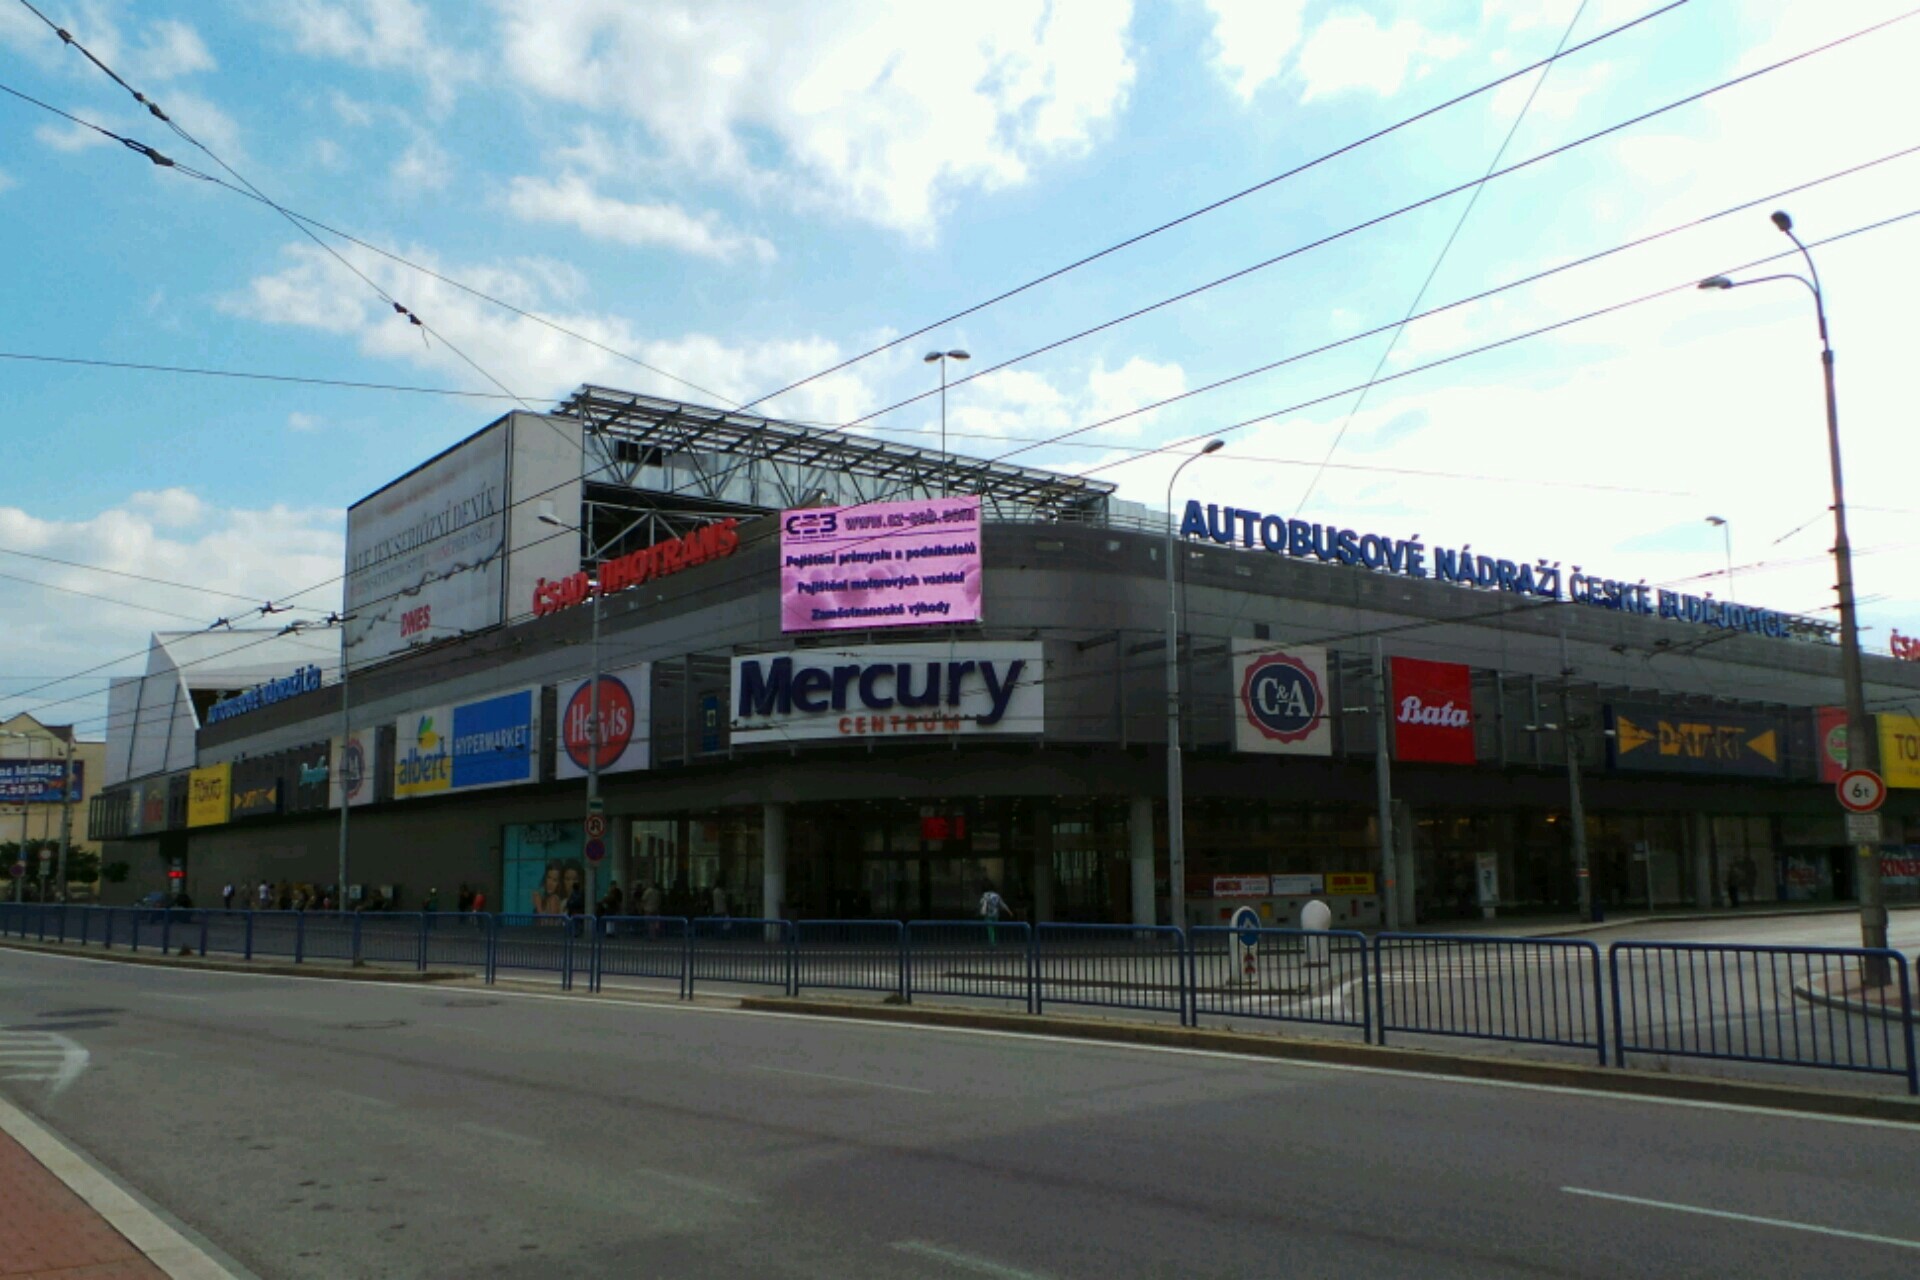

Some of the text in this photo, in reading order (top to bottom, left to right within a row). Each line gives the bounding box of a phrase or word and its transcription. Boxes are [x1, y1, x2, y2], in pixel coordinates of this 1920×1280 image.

[532, 516, 740, 619] ČSAD JIHOTRANS
[895, 550, 902, 559] a
[1180, 499, 1792, 639] AUTOBUSOVÉ NÁDRAŽÍ ČESKÉ BUDĚJOVICE
[851, 574, 919, 590] motorových
[922, 571, 966, 584] vozidel
[401, 604, 432, 638] DNES
[908, 600, 951, 617] výhody
[739, 656, 1026, 726] Mercury
[1256, 677, 1311, 718] C&A
[456, 724, 529, 756] HYPERMARKET
[838, 715, 961, 735] CENTRUM
[398, 736, 448, 786] albert
